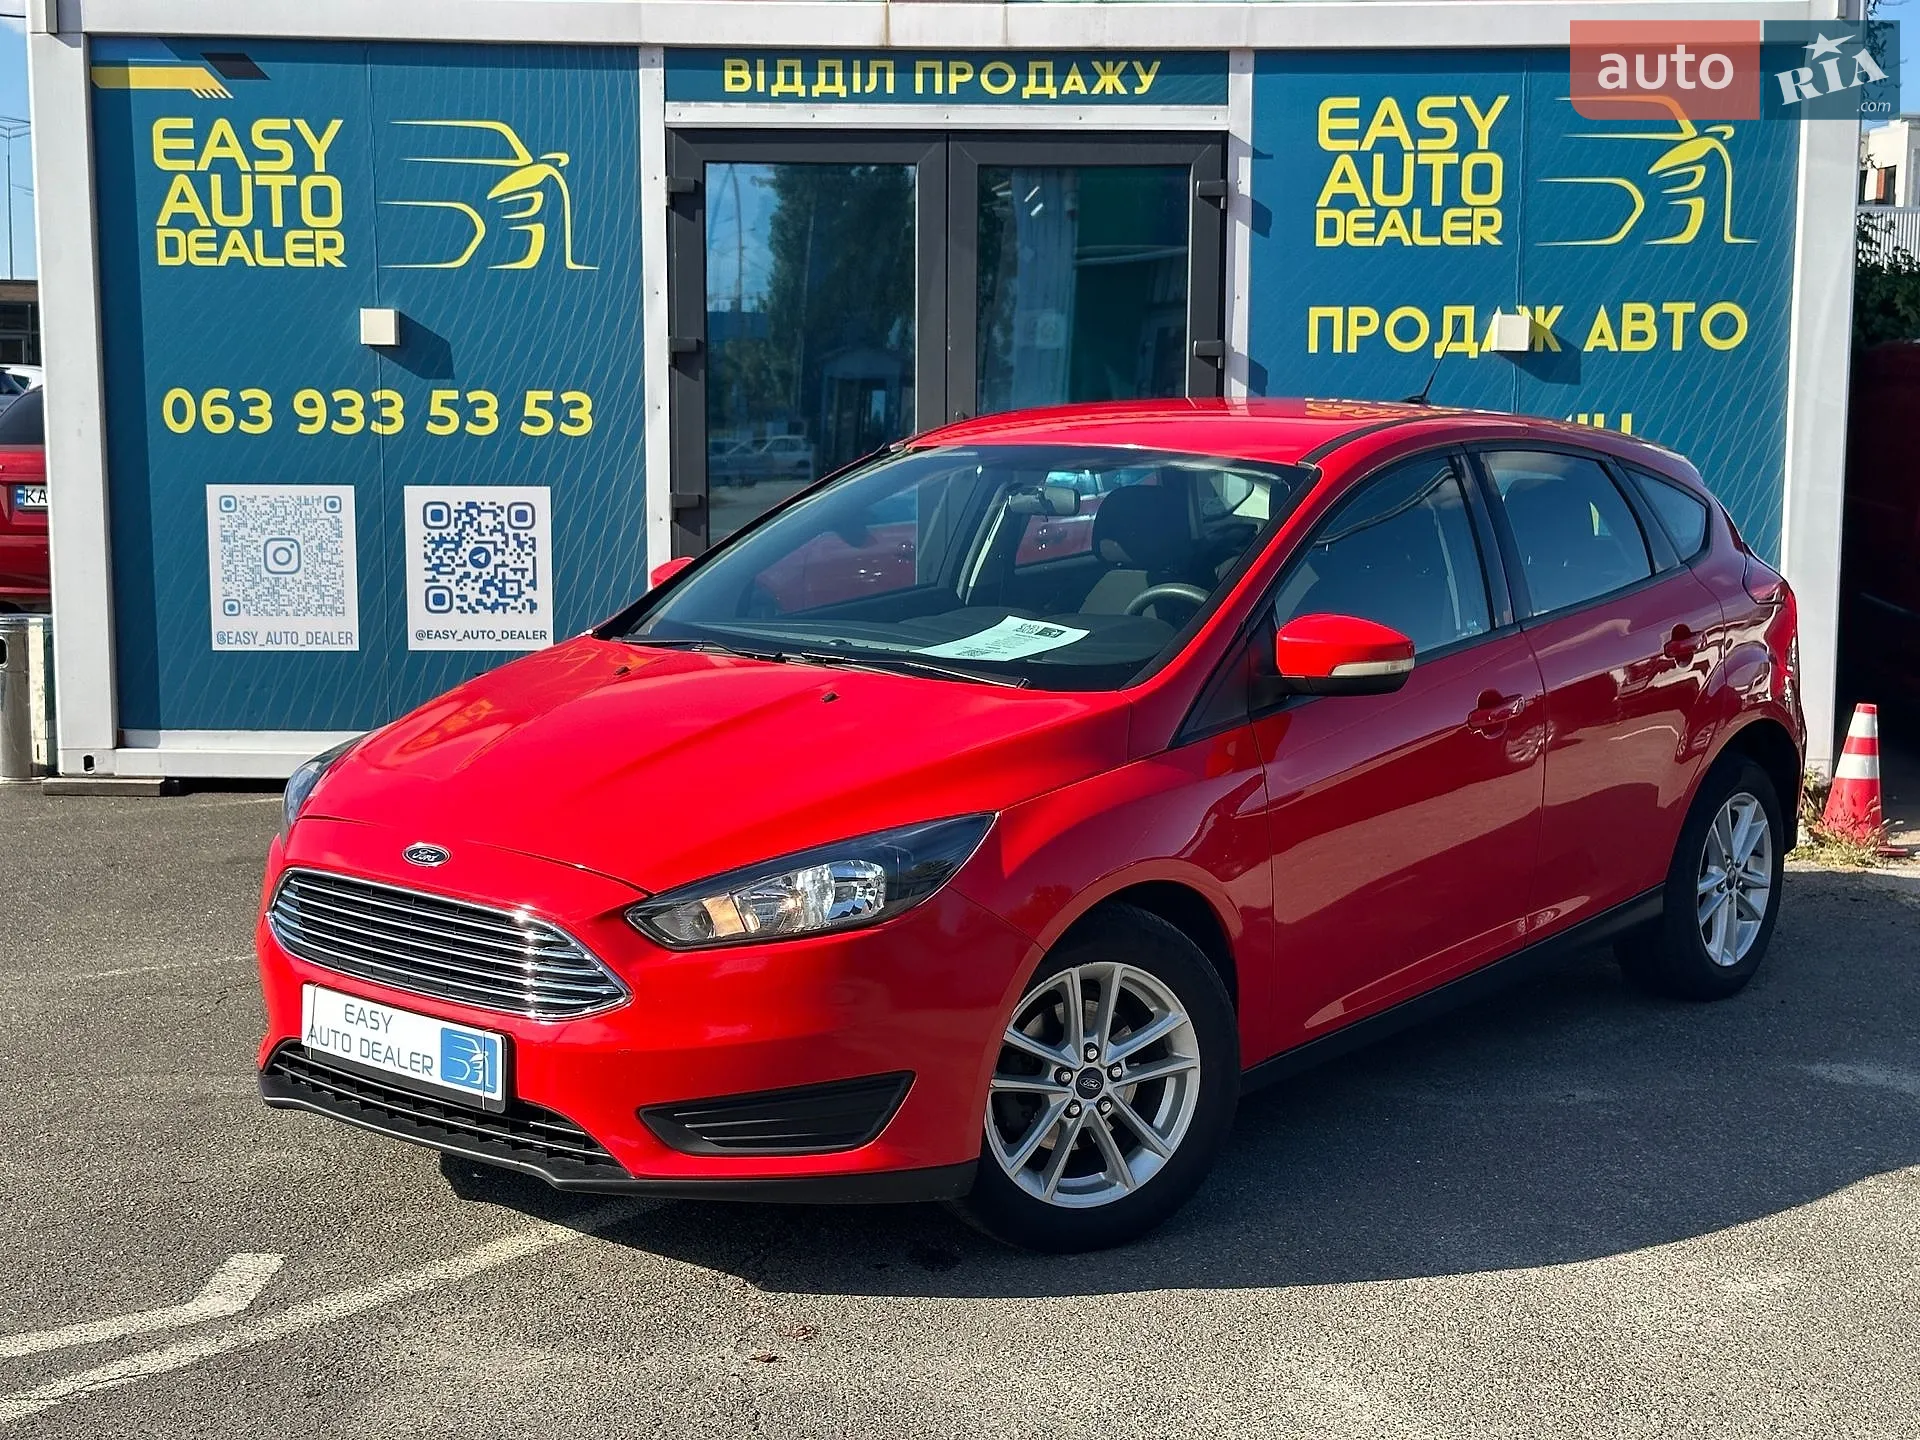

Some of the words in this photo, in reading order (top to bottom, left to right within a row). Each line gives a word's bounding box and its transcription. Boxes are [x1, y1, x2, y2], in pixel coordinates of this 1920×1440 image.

[723, 59, 895, 97] ВІДДІЛ
[914, 60, 1161, 99] ПРОДАЖУ
[152, 117, 344, 172] EASY
[1317, 95, 1509, 152] EASY
[157, 174, 344, 228] AUTO
[1317, 152, 1504, 208] AUTO
[156, 228, 347, 267] DEALER
[1315, 207, 1504, 247] DEALER
[1583, 301, 1748, 352] АВТО
[162, 387, 273, 435] 063
[293, 388, 405, 435] 933
[426, 389, 499, 436] 53
[520, 390, 594, 437] 53
[215, 630, 354, 647] @EASY_AUTO_DEALER
[415, 629, 548, 643] @EASY_AUTO_DEALER
[344, 1003, 393, 1034] EASY
[306, 1024, 352, 1054] AUTO
[359, 1037, 434, 1077] DEALER
